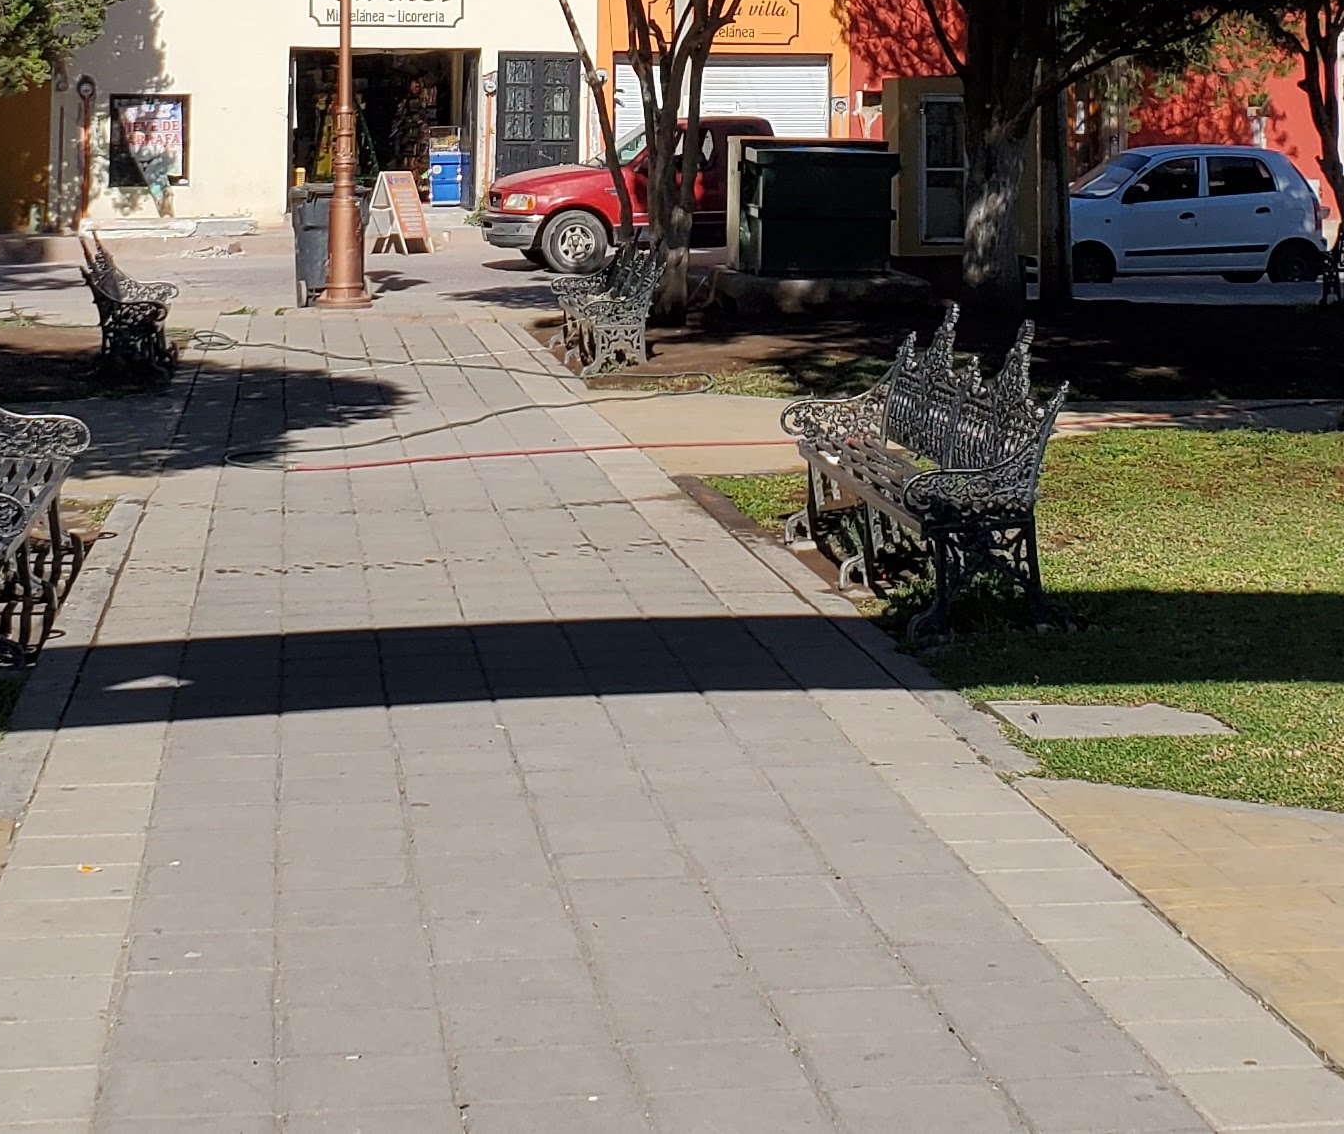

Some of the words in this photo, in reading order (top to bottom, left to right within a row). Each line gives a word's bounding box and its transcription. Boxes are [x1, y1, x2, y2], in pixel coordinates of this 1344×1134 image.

[326, 9, 385, 23] Mielánea
[748, 0, 789, 18] villa
[163, 121, 180, 131] DE
